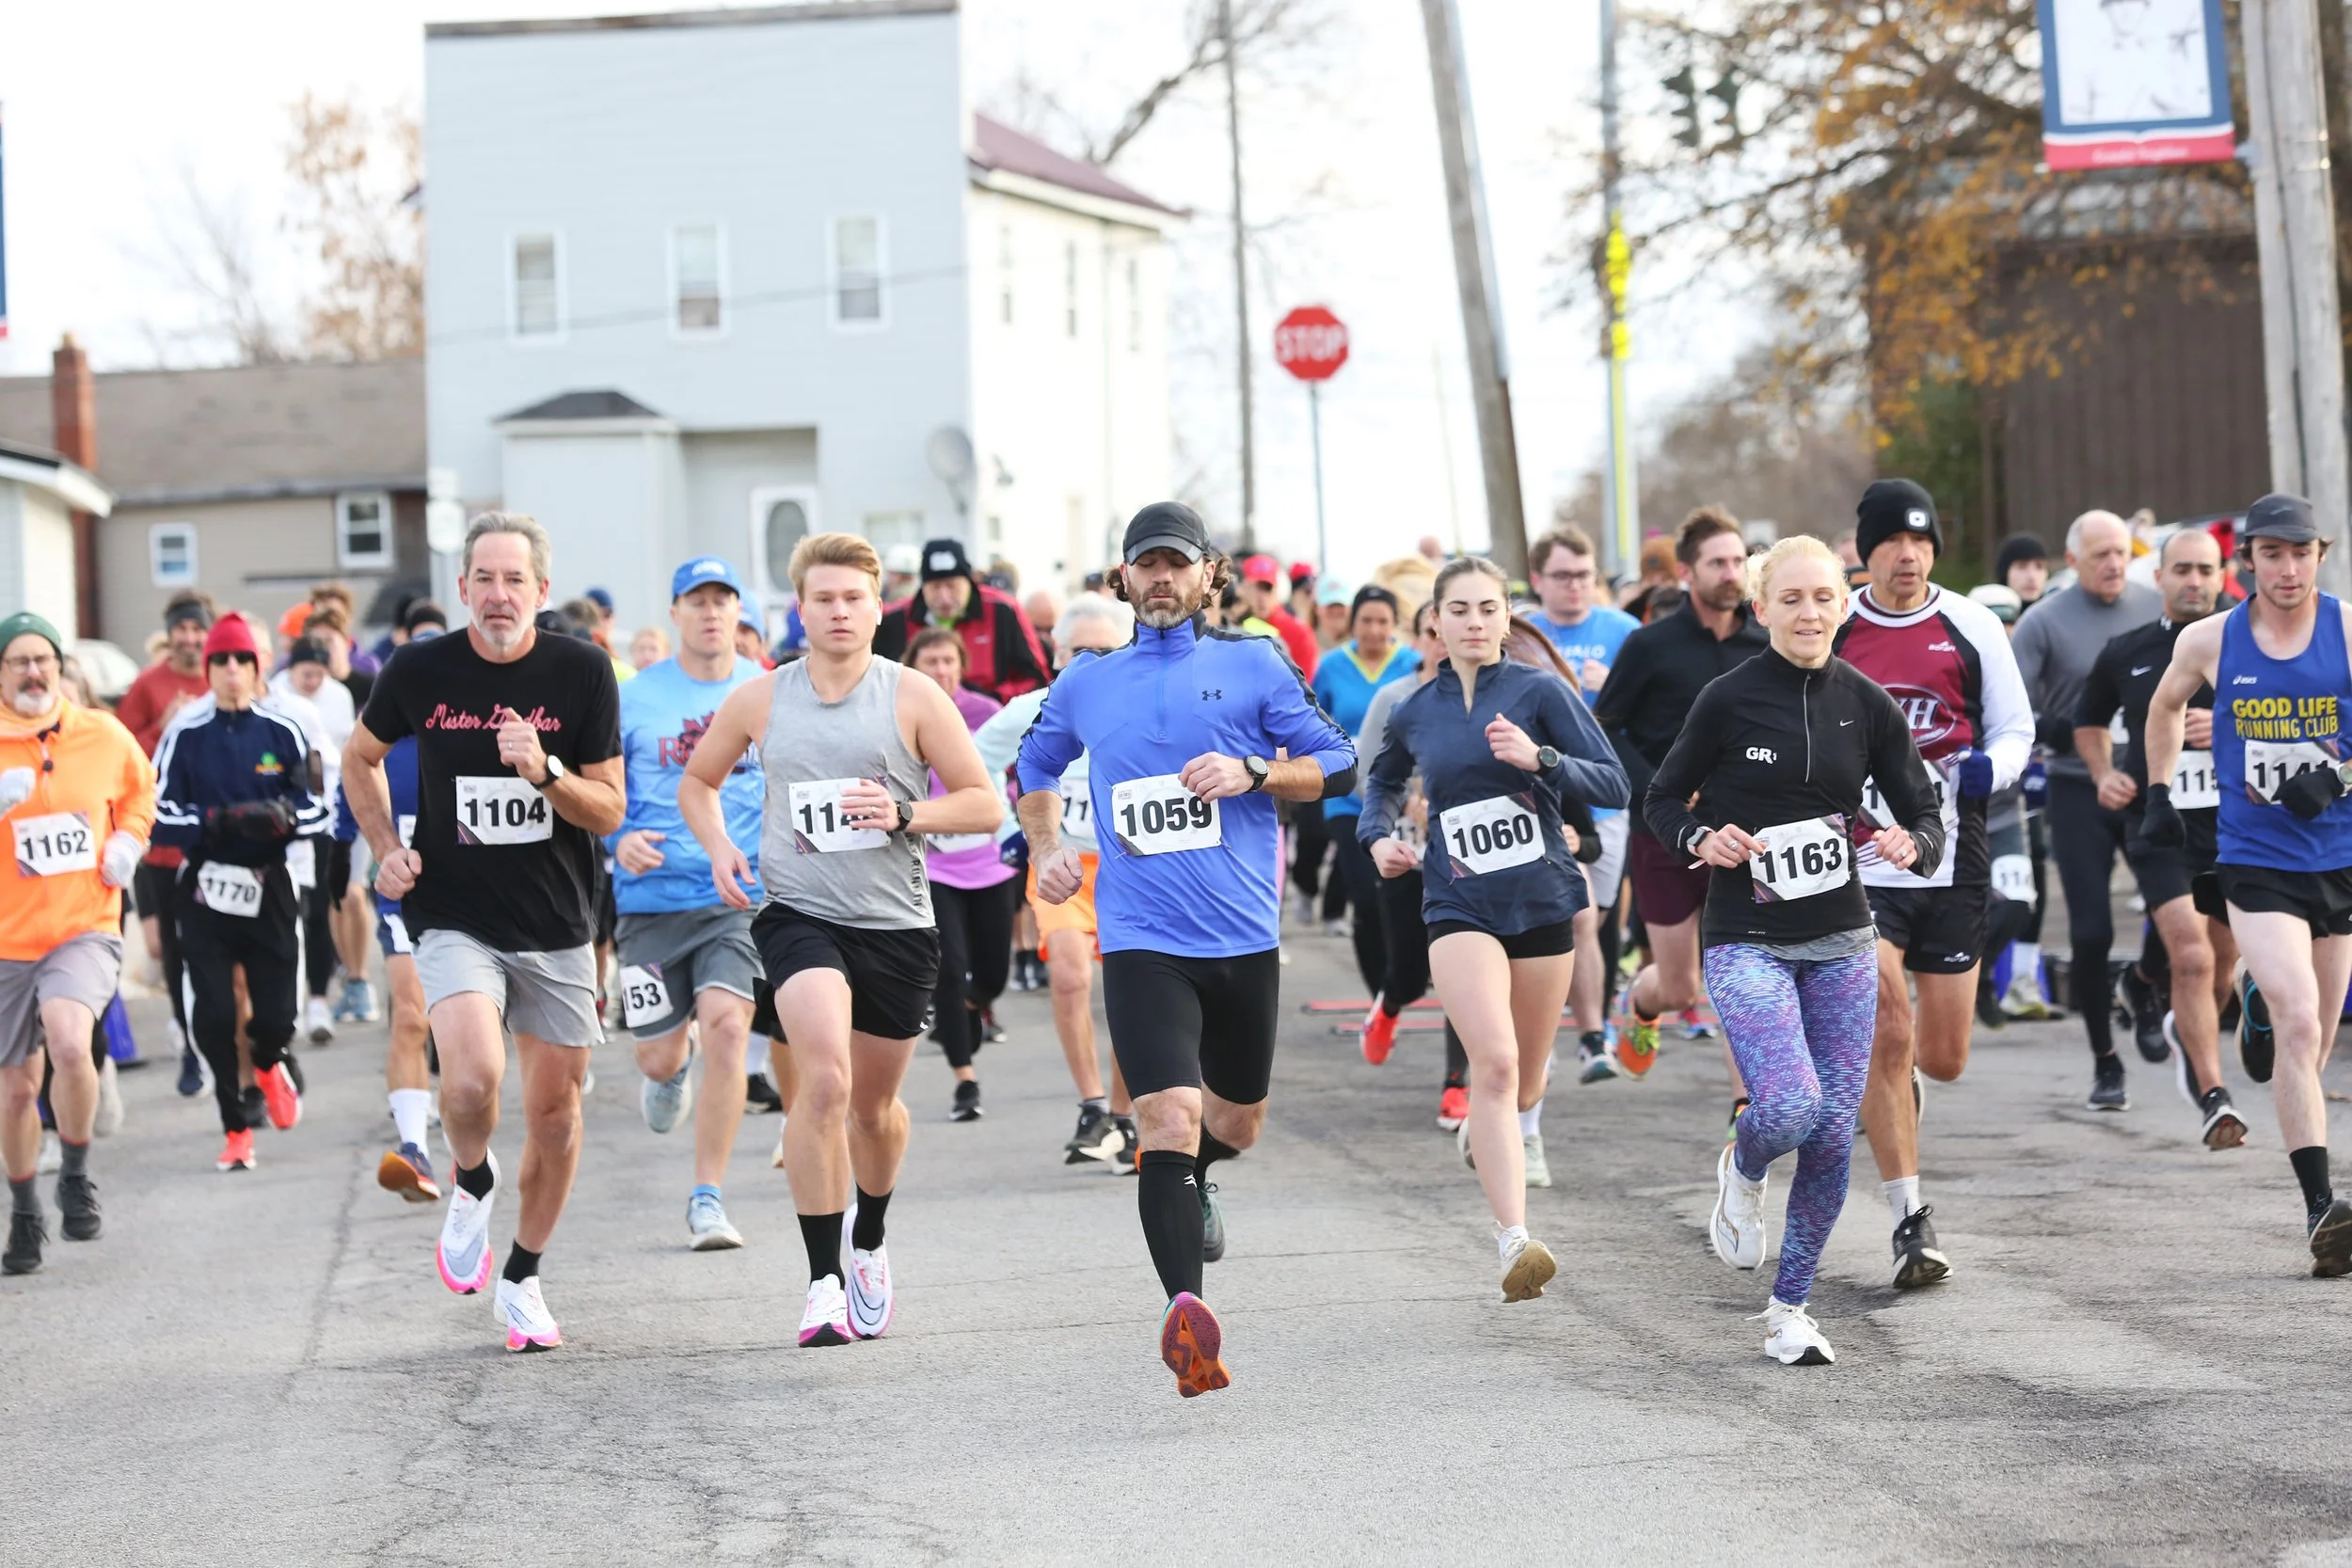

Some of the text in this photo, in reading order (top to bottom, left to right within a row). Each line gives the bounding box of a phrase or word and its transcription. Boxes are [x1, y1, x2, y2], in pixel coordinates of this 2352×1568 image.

[1275, 325, 1348, 362] STOP
[425, 704, 483, 730] Mister
[2232, 696, 2338, 719] GOOD LIFE
[2235, 716, 2339, 739] RUNNING CLUB
[465, 797, 547, 828] 1104
[799, 801, 873, 835] 11
[1120, 796, 1212, 837] 1059
[21, 830, 89, 861] 1162
[1453, 814, 1534, 858] 1060
[1758, 837, 1842, 883] 1163
[206, 877, 257, 903] 1170
